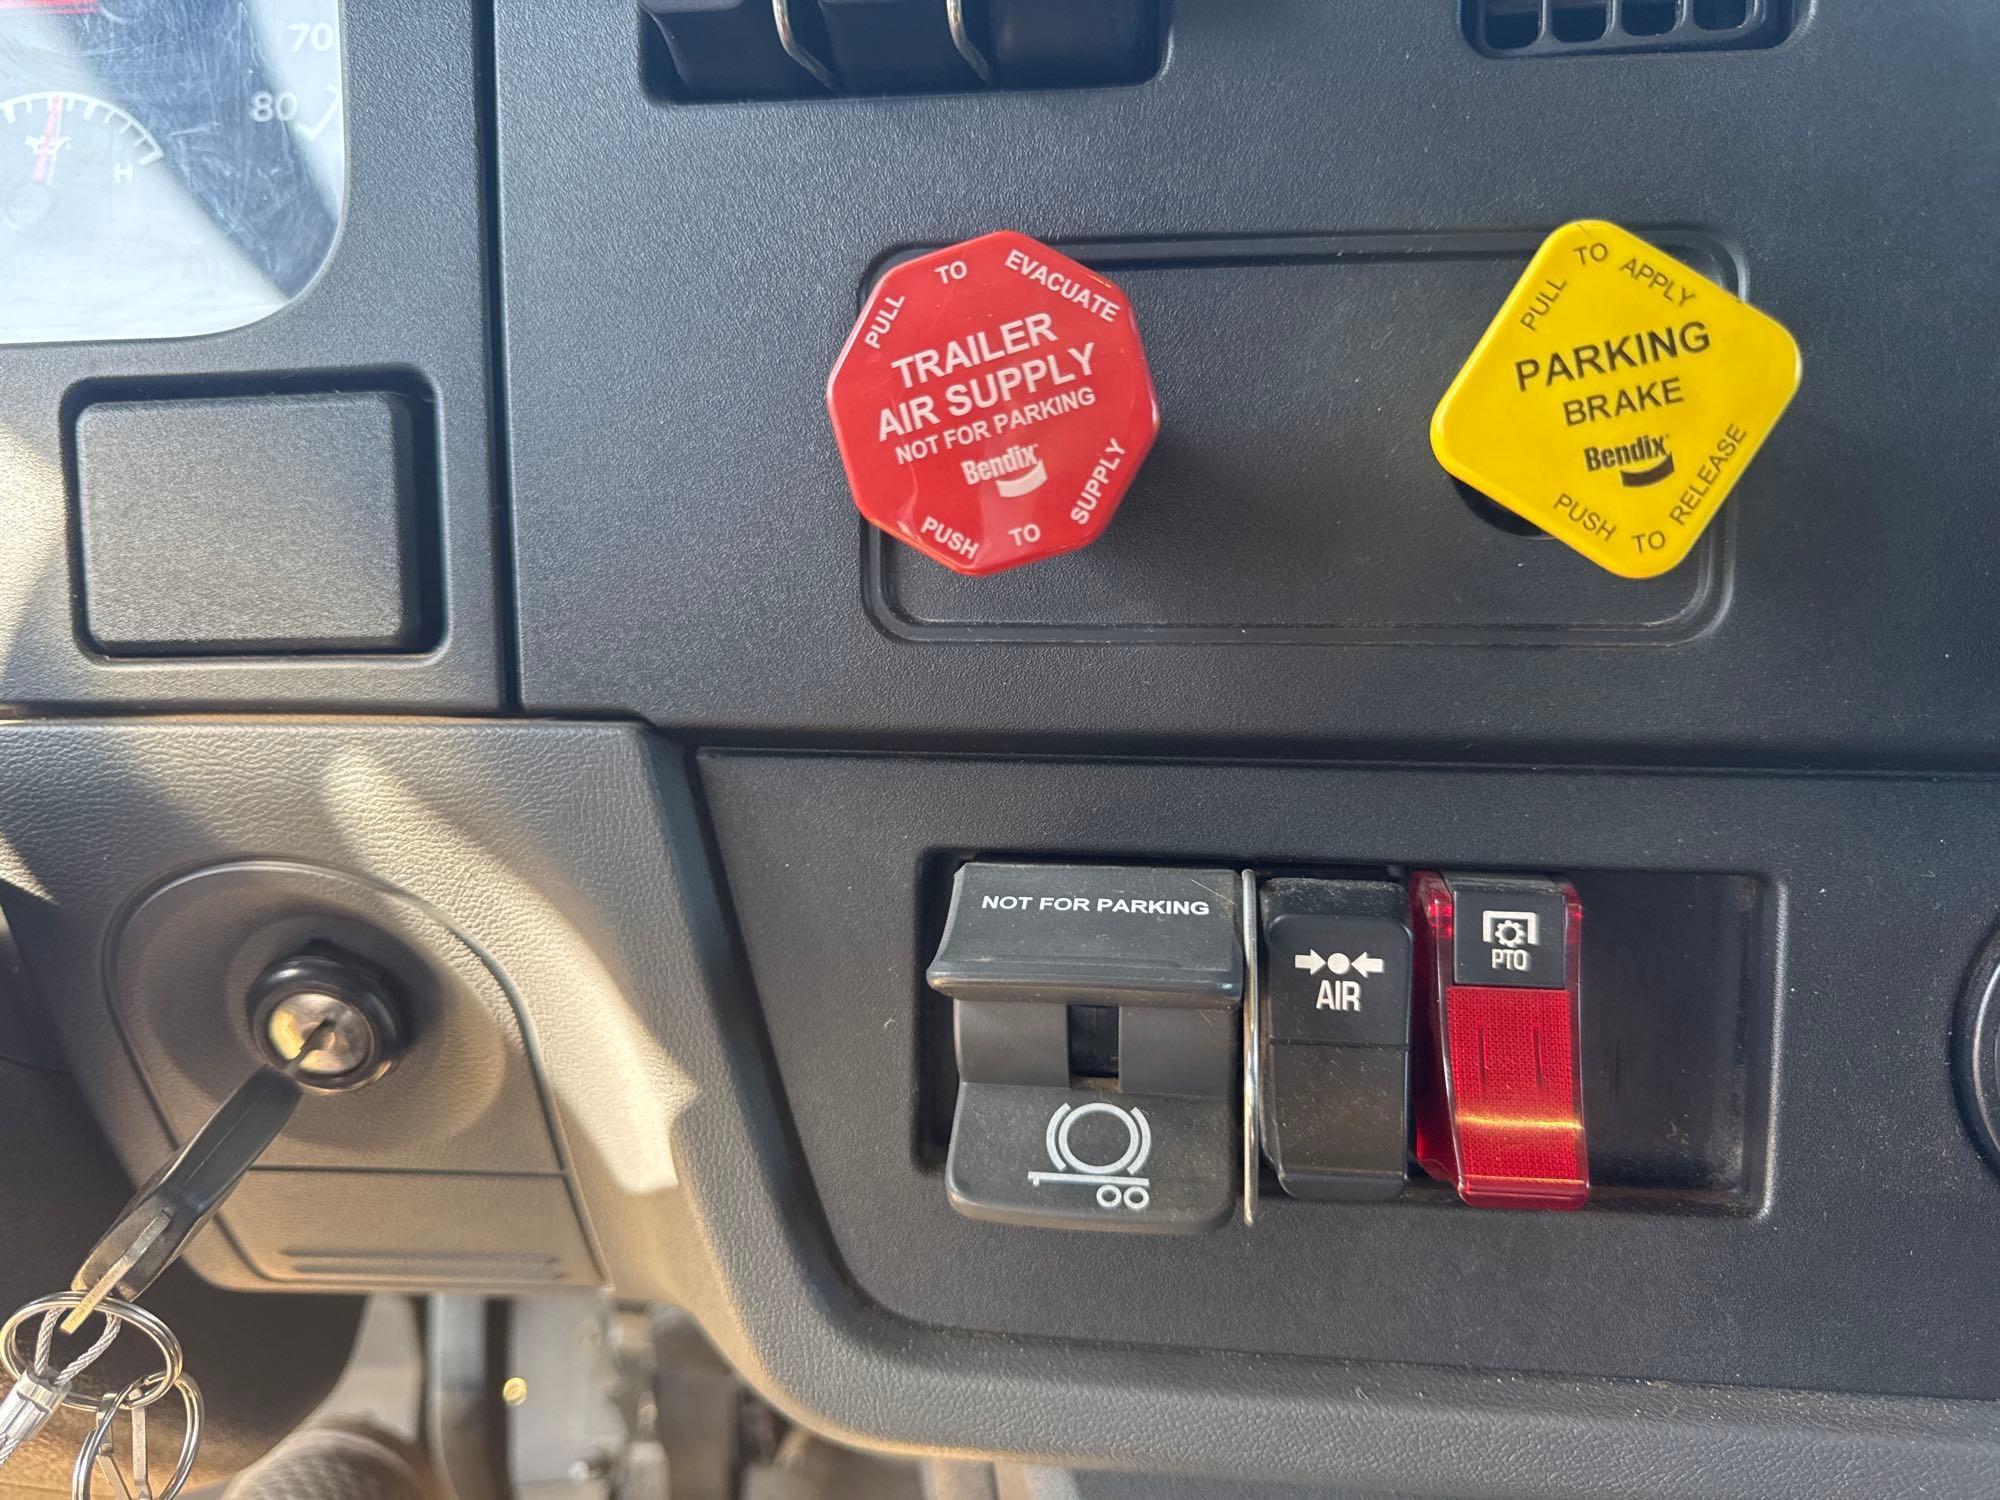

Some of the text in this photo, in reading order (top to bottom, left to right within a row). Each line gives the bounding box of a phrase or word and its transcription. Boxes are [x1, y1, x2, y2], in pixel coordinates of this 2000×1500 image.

[287, 23, 334, 53] 70
[250, 91, 298, 122] 80
[113, 163, 134, 184] H
[865, 249, 1120, 349] PULL TO EVACUATE
[1519, 242, 1696, 332] PULL TO APPLY
[891, 312, 1058, 389] TRAILER
[1514, 321, 1710, 393] PARKING
[878, 342, 1096, 442] AIR SUPPLY
[1562, 377, 1684, 427] BRAKE
[895, 387, 1096, 464] NOT FOR PARKING
[961, 444, 1038, 485] Bendix
[1583, 435, 1667, 472] Bendix
[920, 438, 1126, 559] PUSH TO SUPPLY
[1552, 423, 1747, 554] PUSH TO RELEASE
[981, 895, 1210, 916] NOT FOR PARKING
[1491, 949, 1528, 971] PTO
[1315, 980, 1361, 1012] AIR
